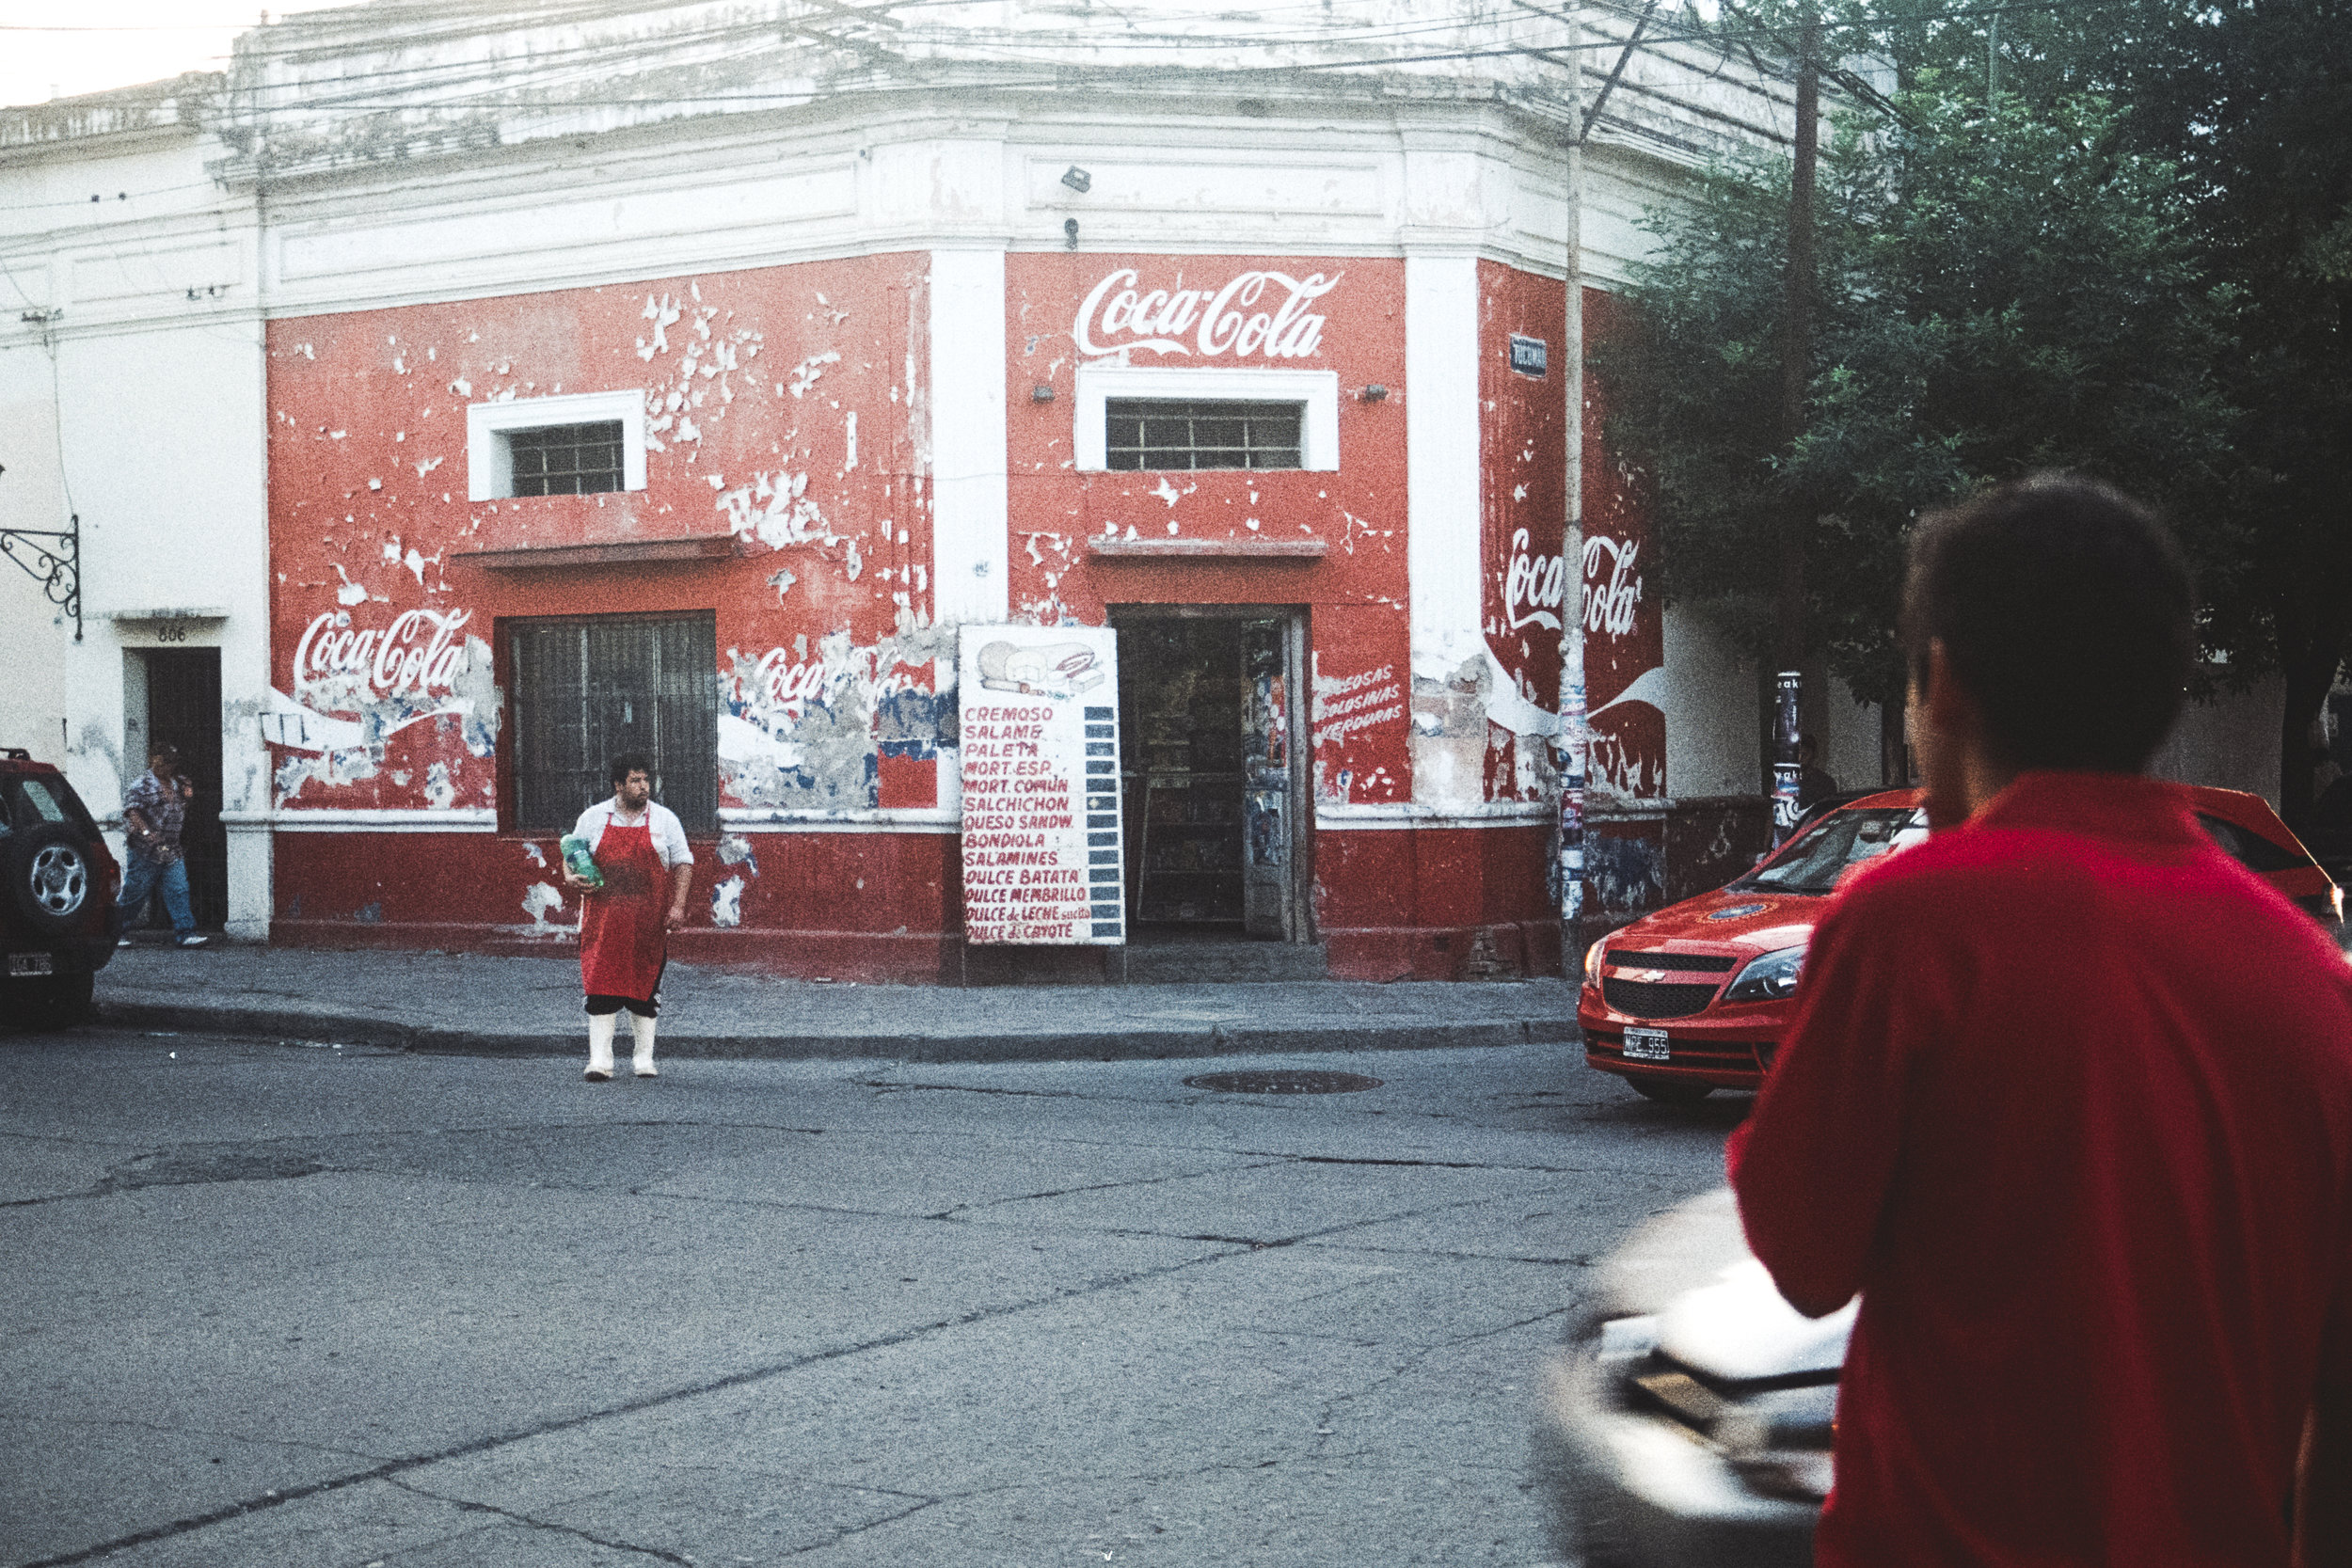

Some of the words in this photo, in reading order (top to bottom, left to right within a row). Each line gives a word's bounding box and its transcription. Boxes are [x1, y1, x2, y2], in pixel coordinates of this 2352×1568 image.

[1073, 269, 1344, 357] Coca-Cola
[294, 608, 472, 689] Coca-Cola
[964, 706, 1053, 721] CREMOSO
[964, 724, 1041, 739] SALAME
[964, 741, 1039, 757] PALETA
[962, 779, 1011, 794] MORT.
[963, 797, 1069, 812] SALCHICHON
[964, 815, 1015, 831] QUESO
[964, 833, 1045, 848] BONDIOLA
[964, 851, 1058, 866] SALAMINES
[965, 870, 1015, 885] DULCE
[1019, 869, 1079, 885] BATATA
[965, 888, 1007, 903] DULCE
[1009, 887, 1086, 903] MEMBRILLO
[965, 907, 1007, 922] DULCE
[1022, 906, 1059, 921] LECHE
[965, 925, 1007, 941] DULCE
[1648, 1037, 1667, 1054] 955
